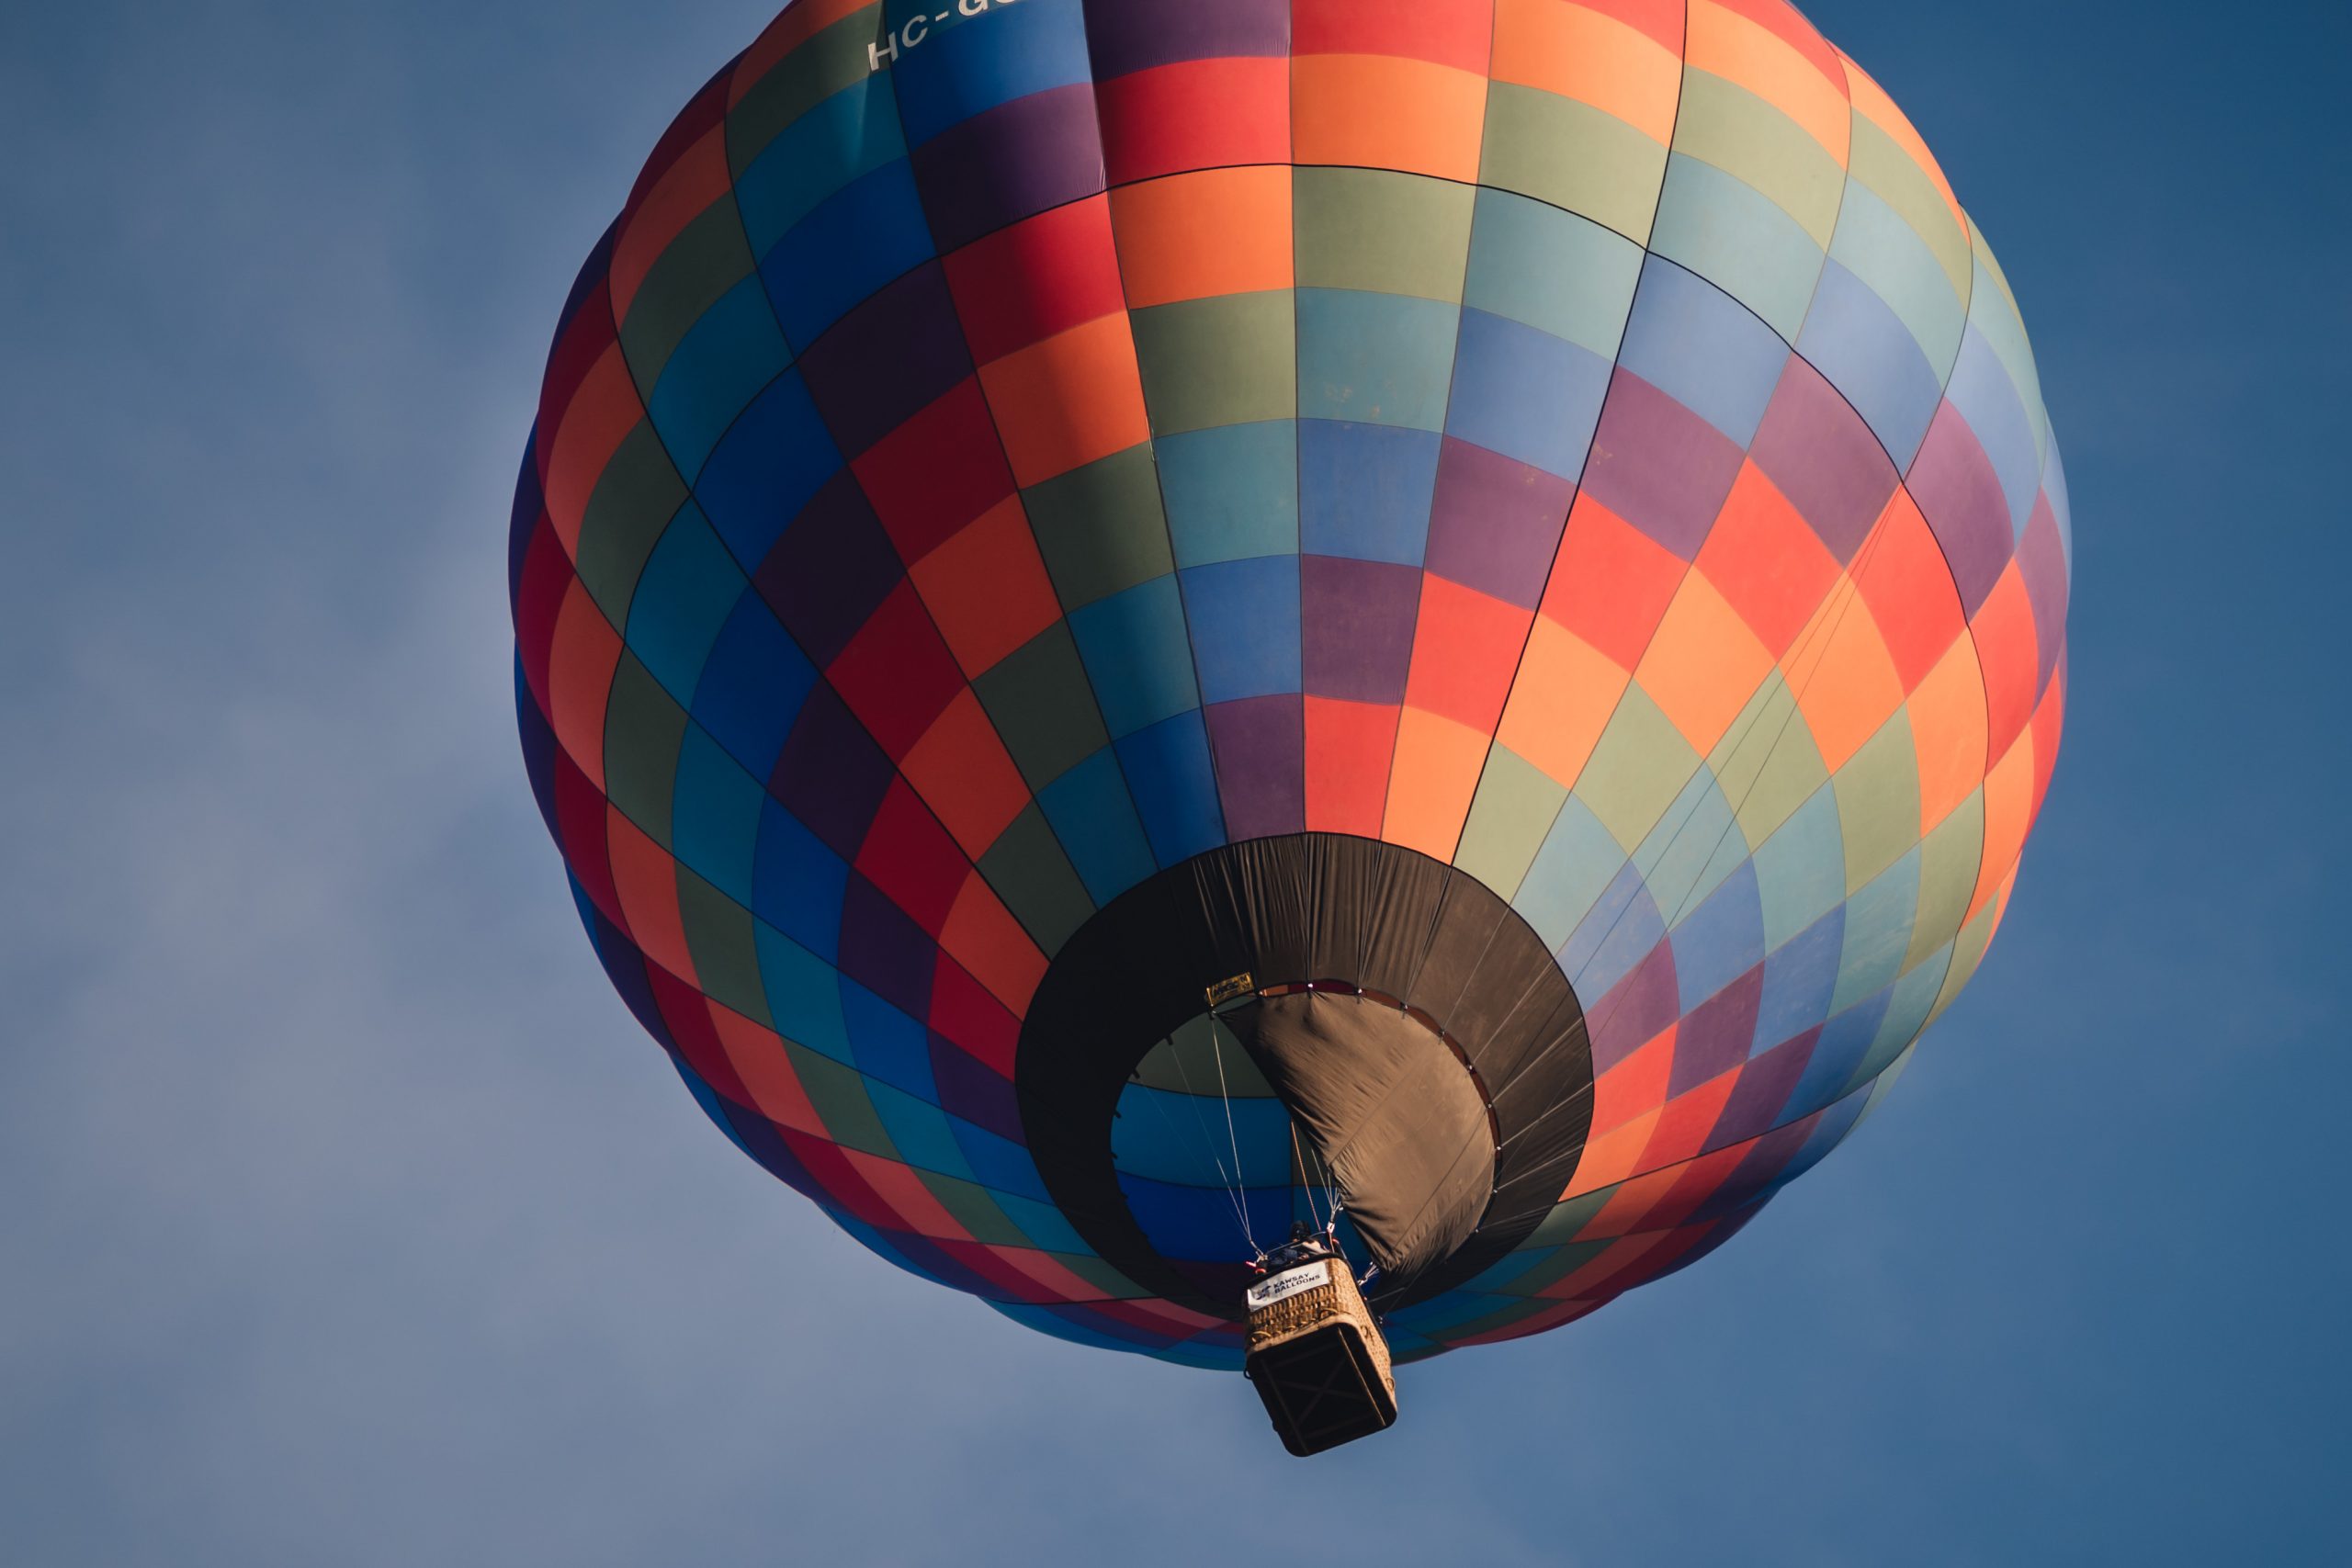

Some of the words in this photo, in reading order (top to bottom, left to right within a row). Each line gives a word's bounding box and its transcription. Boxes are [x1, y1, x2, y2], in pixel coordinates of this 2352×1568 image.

[867, 0, 1015, 71] HC-G
[1273, 1273, 1309, 1288] KAWSAY
[1274, 1275, 1320, 1293] BALLOONS
